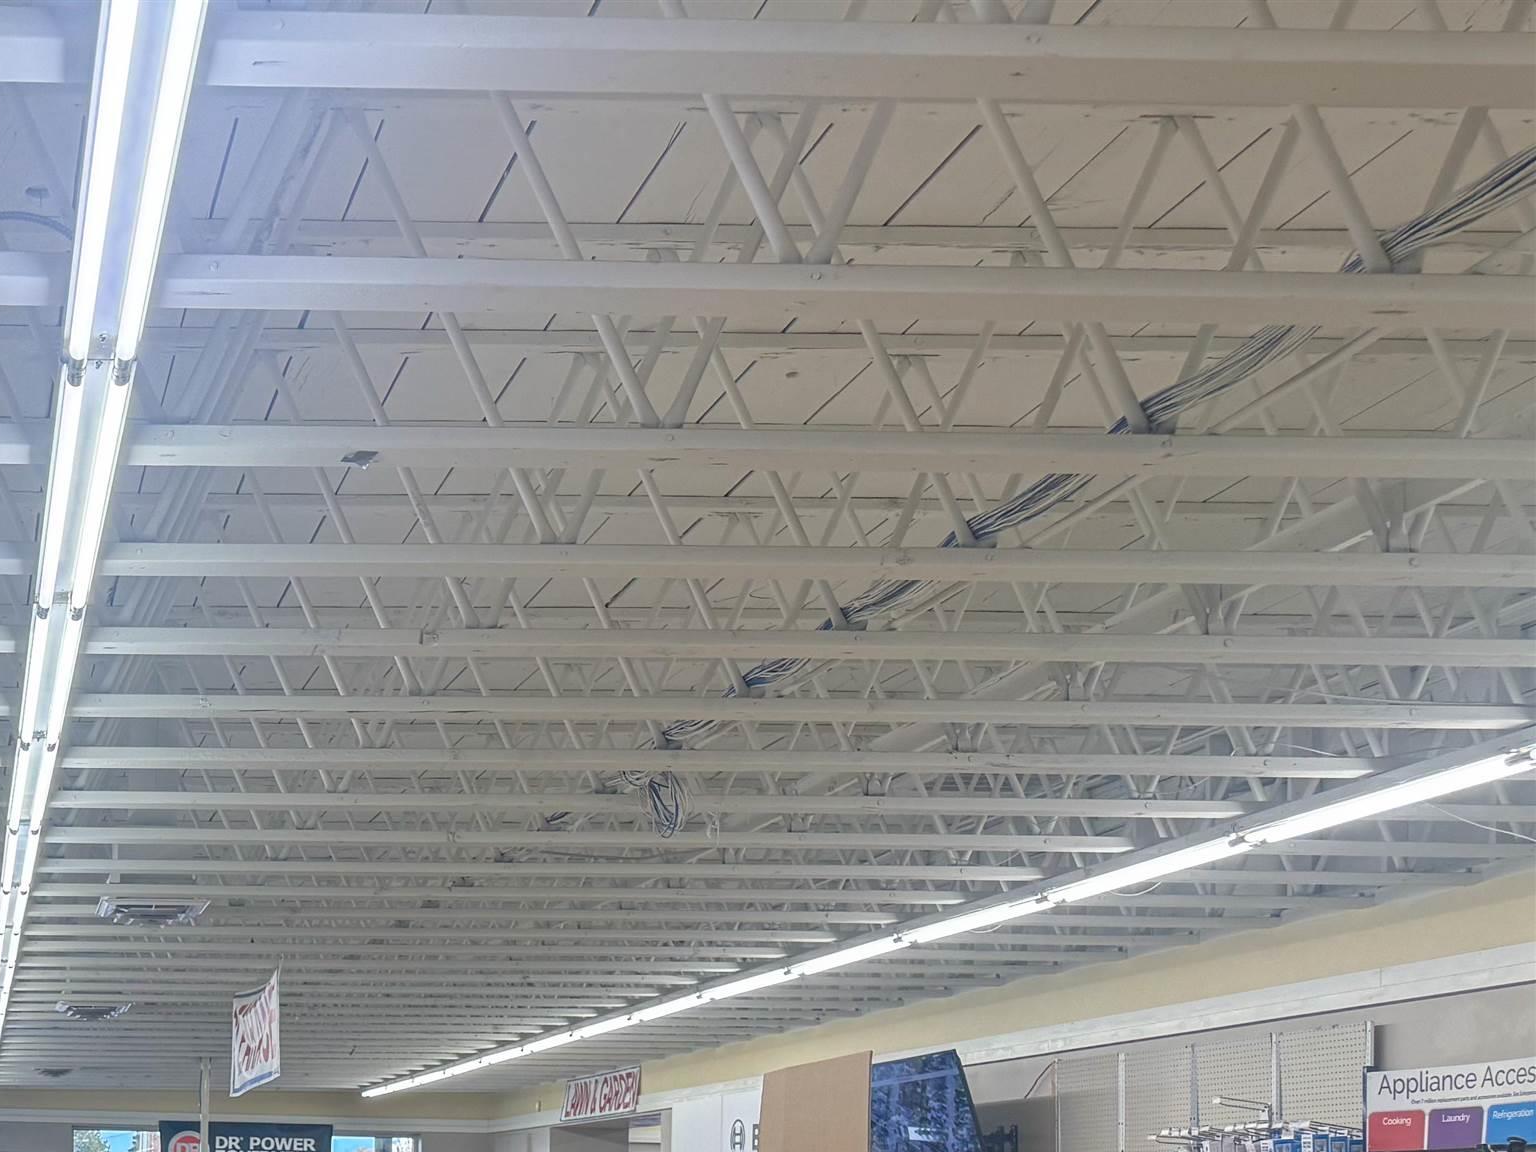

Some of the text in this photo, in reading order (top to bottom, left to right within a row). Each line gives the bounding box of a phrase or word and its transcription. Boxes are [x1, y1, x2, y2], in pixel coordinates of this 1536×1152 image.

[1378, 1064, 1536, 1100] Appliance Acces
[564, 1079, 591, 1118] LAWN
[598, 1070, 640, 1114] GARDEN
[1442, 1113, 1471, 1124] Laundry
[1492, 1108, 1534, 1120] Refrigeration
[1382, 1116, 1412, 1127] Cooking
[249, 1136, 316, 1152] POWER
